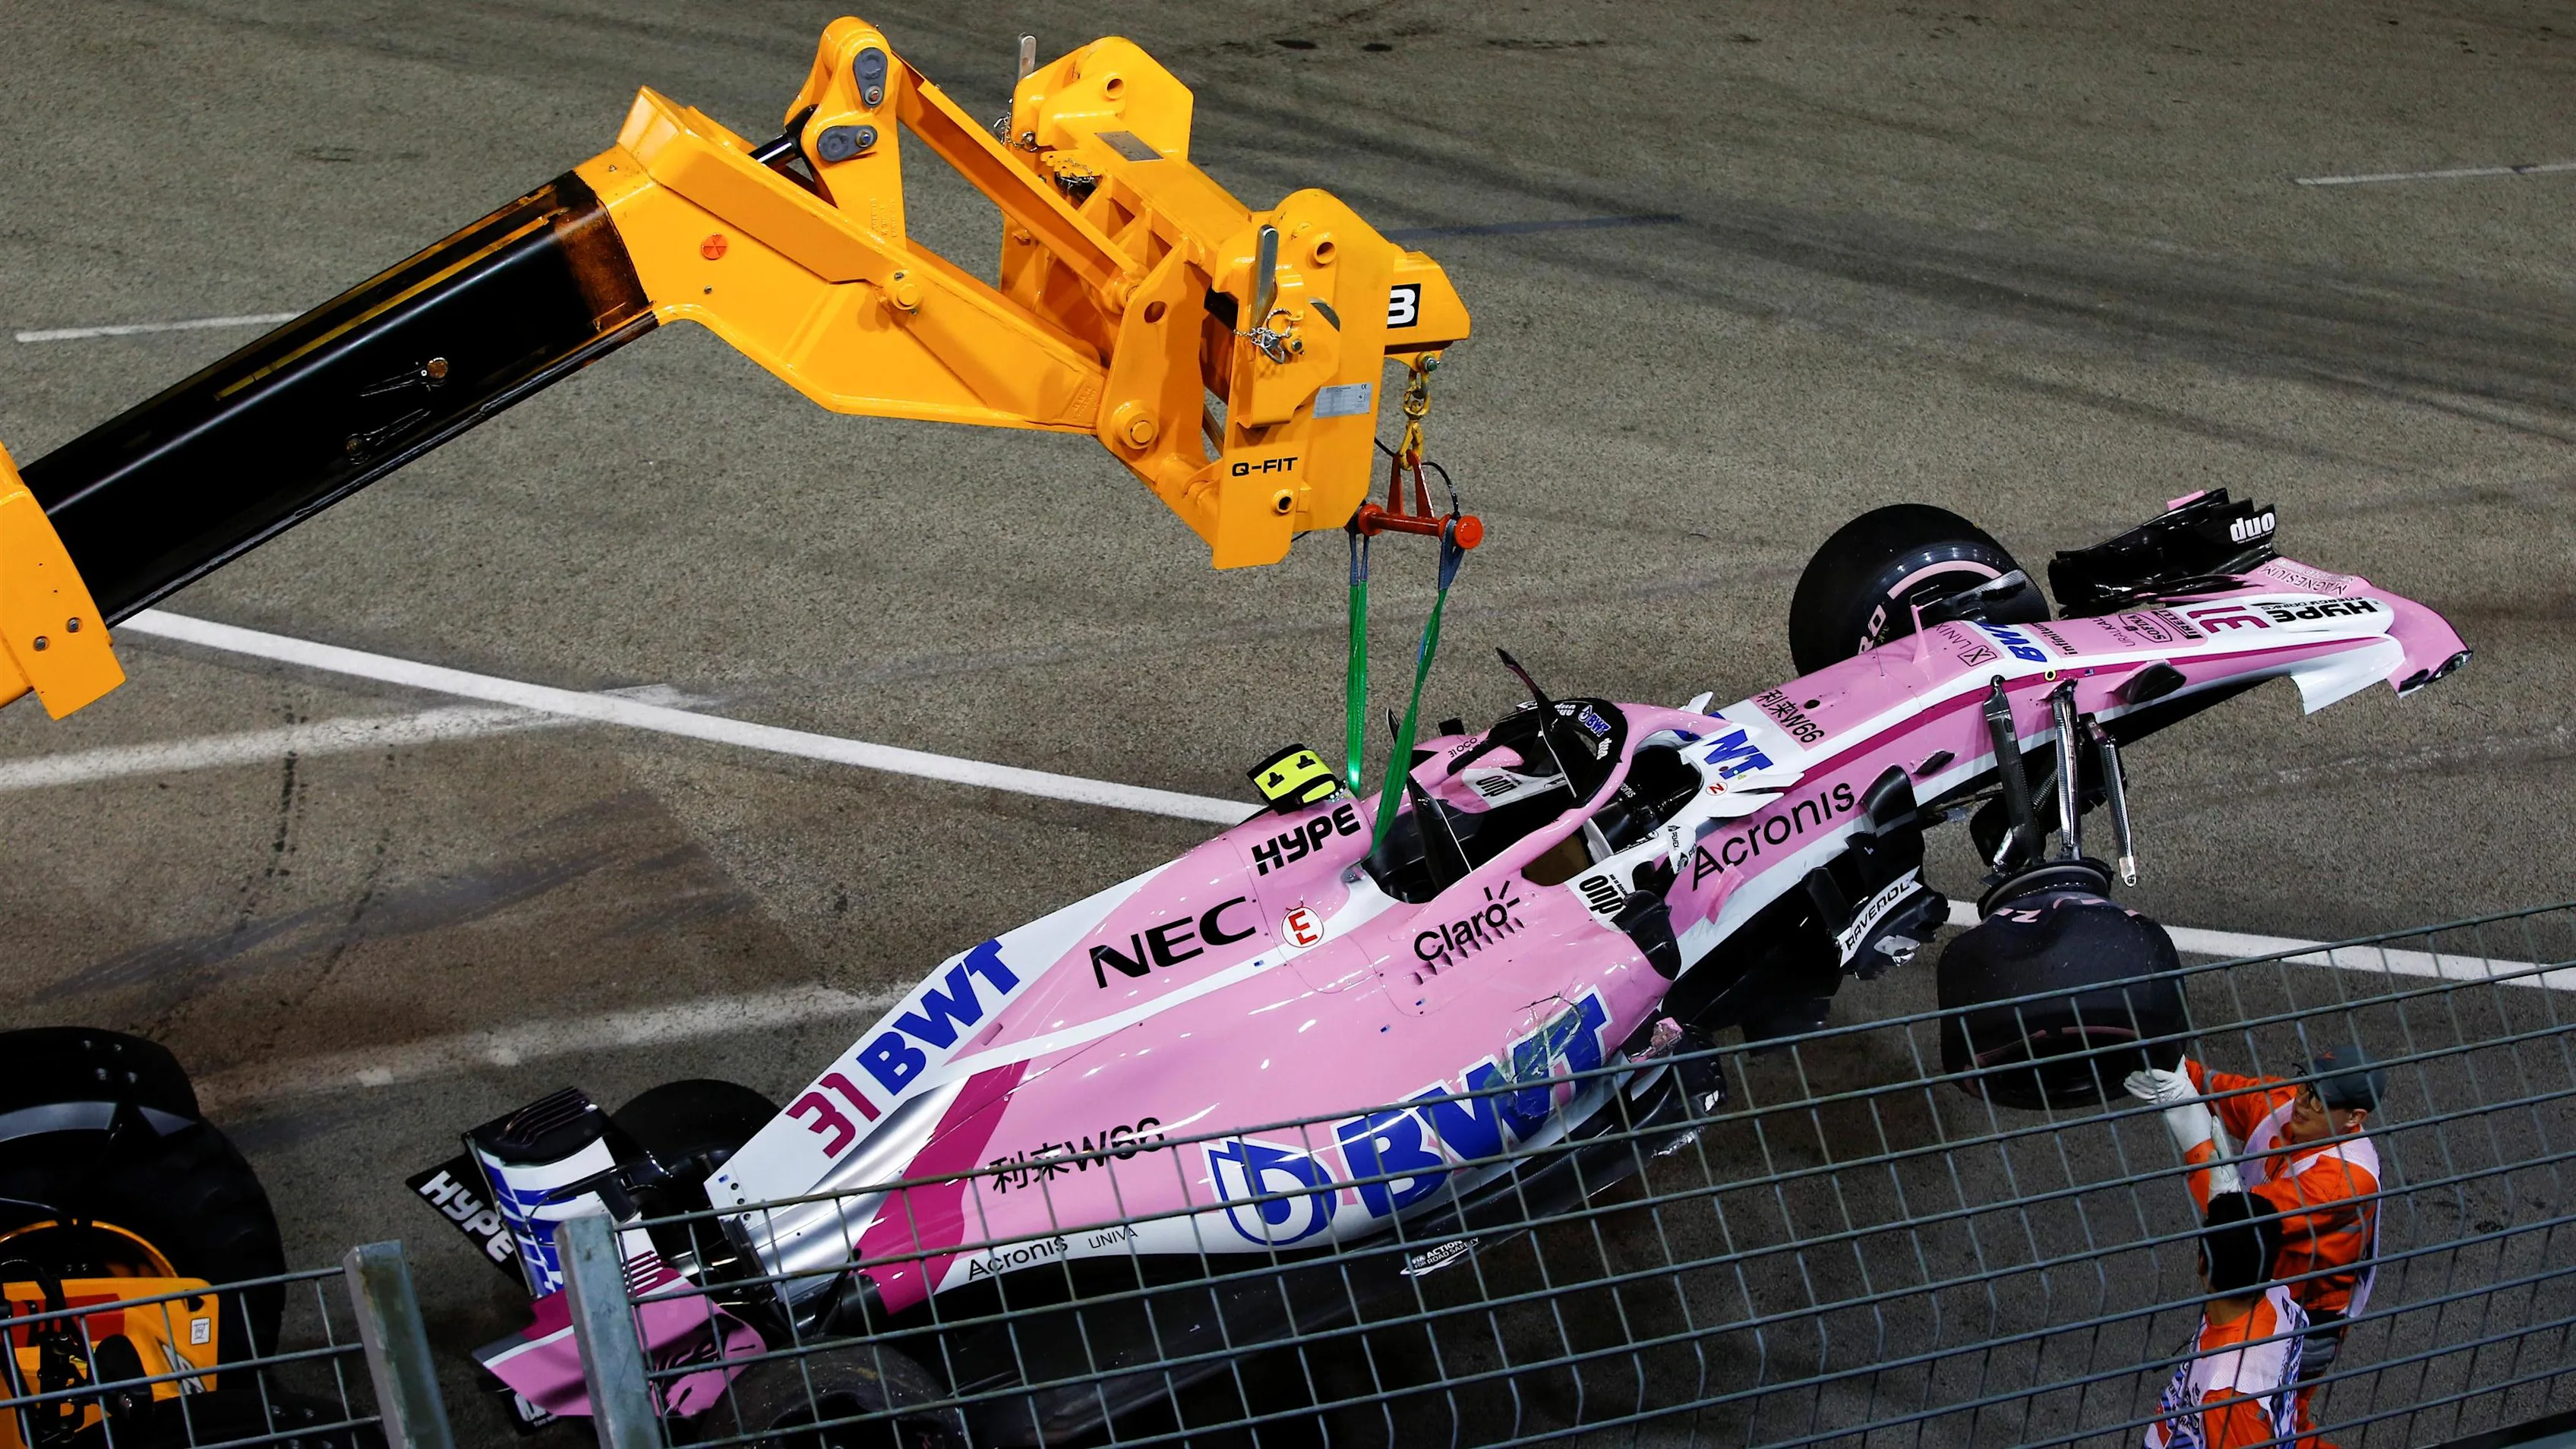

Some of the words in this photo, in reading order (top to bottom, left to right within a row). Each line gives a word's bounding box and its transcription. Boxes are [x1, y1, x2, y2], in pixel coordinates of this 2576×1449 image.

[1232, 456, 1298, 477] Q-FIT
[2230, 512, 2276, 542] duo
[2260, 565, 2350, 596] MAGNESIUM
[2127, 614, 2167, 639] SOFINA
[2186, 605, 2271, 633] 31
[2261, 602, 2306, 611] DRINKS
[2266, 600, 2378, 623] HYPE
[1584, 712, 1612, 737] BWT
[1756, 689, 1825, 743] 利来W66
[1252, 803, 1362, 876] HYPE
[1692, 781, 1855, 892] Acronis
[1579, 874, 1625, 914] duo
[1845, 882, 1910, 951] RAVENOL
[1088, 896, 1257, 989] NEC
[1414, 901, 1507, 961] Claro
[856, 939, 1020, 1096] BWT
[785, 1072, 882, 1159] 31
[1334, 989, 1609, 1220] BWT
[419, 1170, 515, 1263] HYPE
[968, 1234, 1068, 1281] Acronis
[1088, 1226, 1138, 1250] UNIVA
[1426, 1251, 1450, 1264] ROAD
[1427, 1240, 1463, 1258] ACTION
